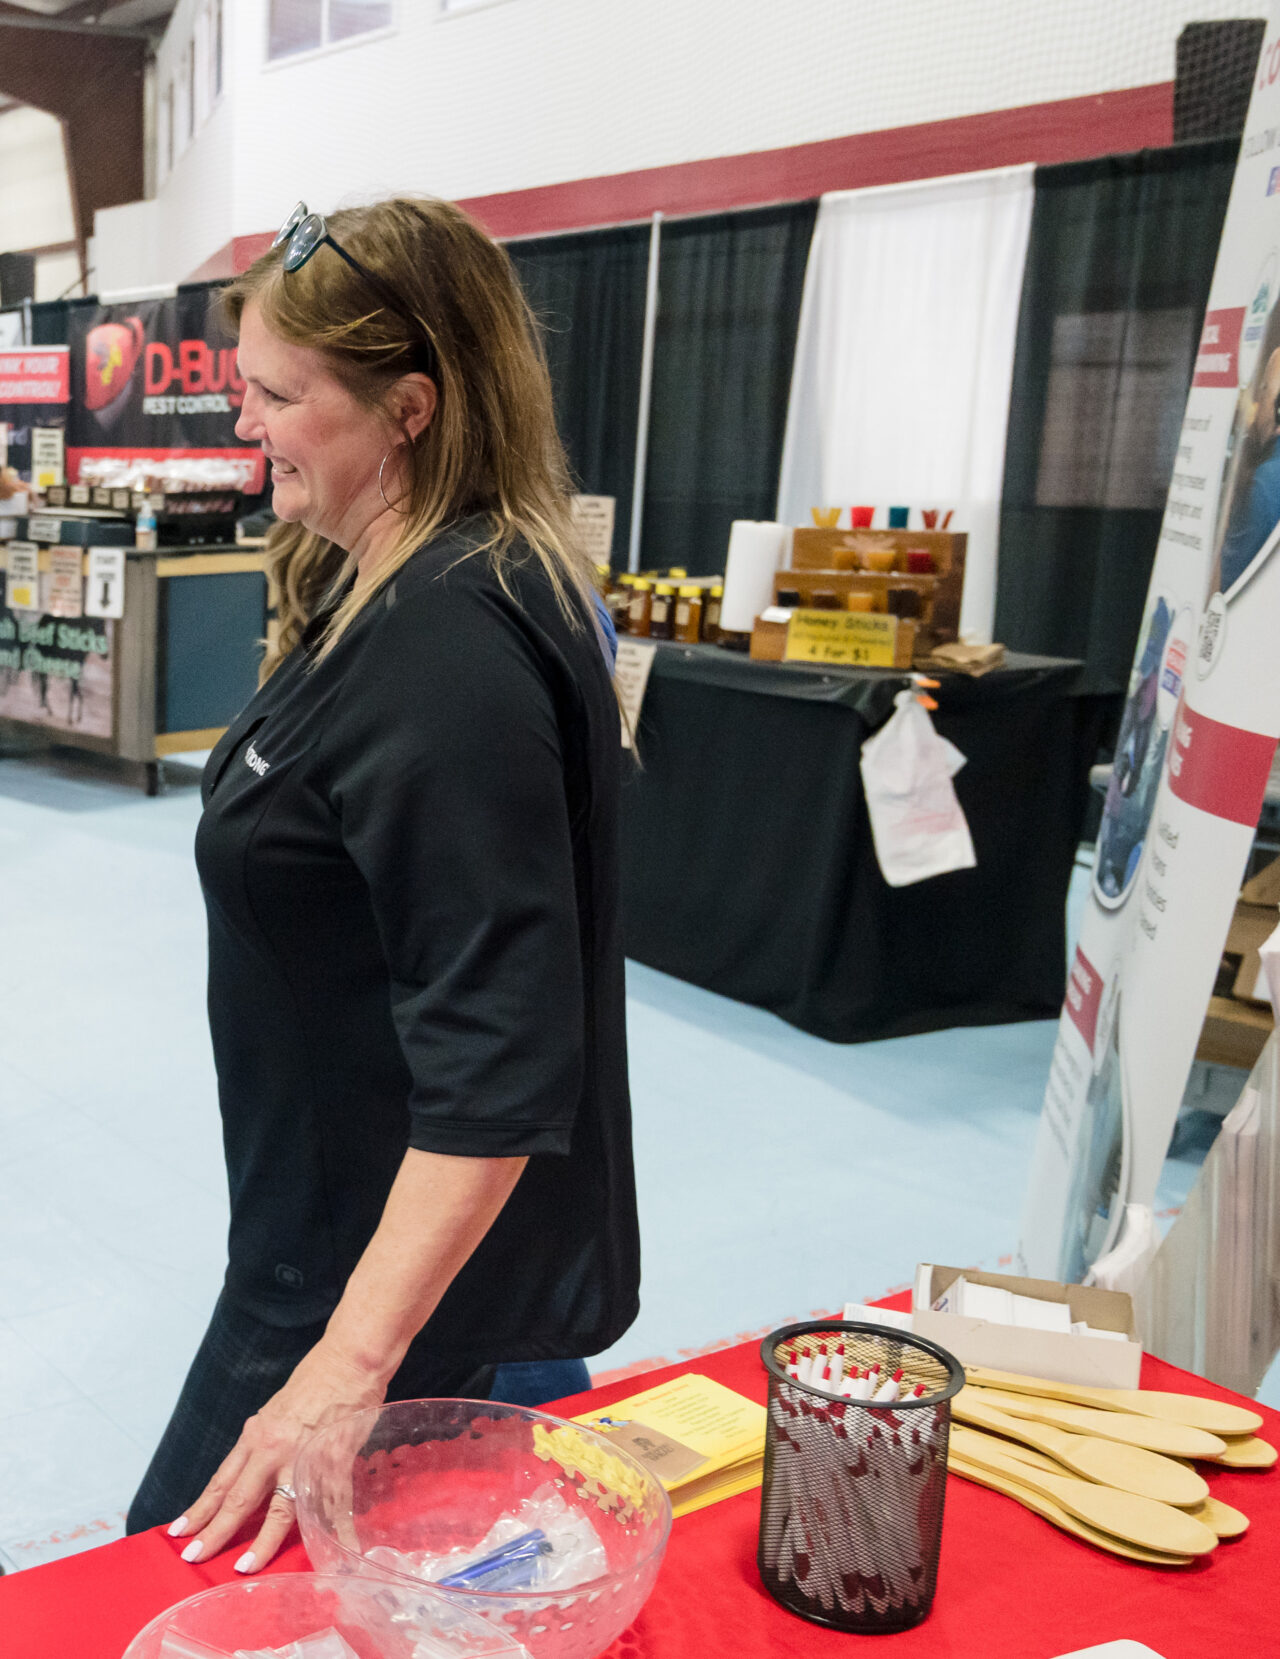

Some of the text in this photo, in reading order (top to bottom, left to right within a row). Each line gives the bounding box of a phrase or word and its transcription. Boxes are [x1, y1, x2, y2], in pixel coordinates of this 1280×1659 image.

[23, 356, 60, 374] YOUR
[143, 396, 176, 415] PEST
[797, 614, 838, 630] Honey
[57, 622, 109, 655] Sticks
